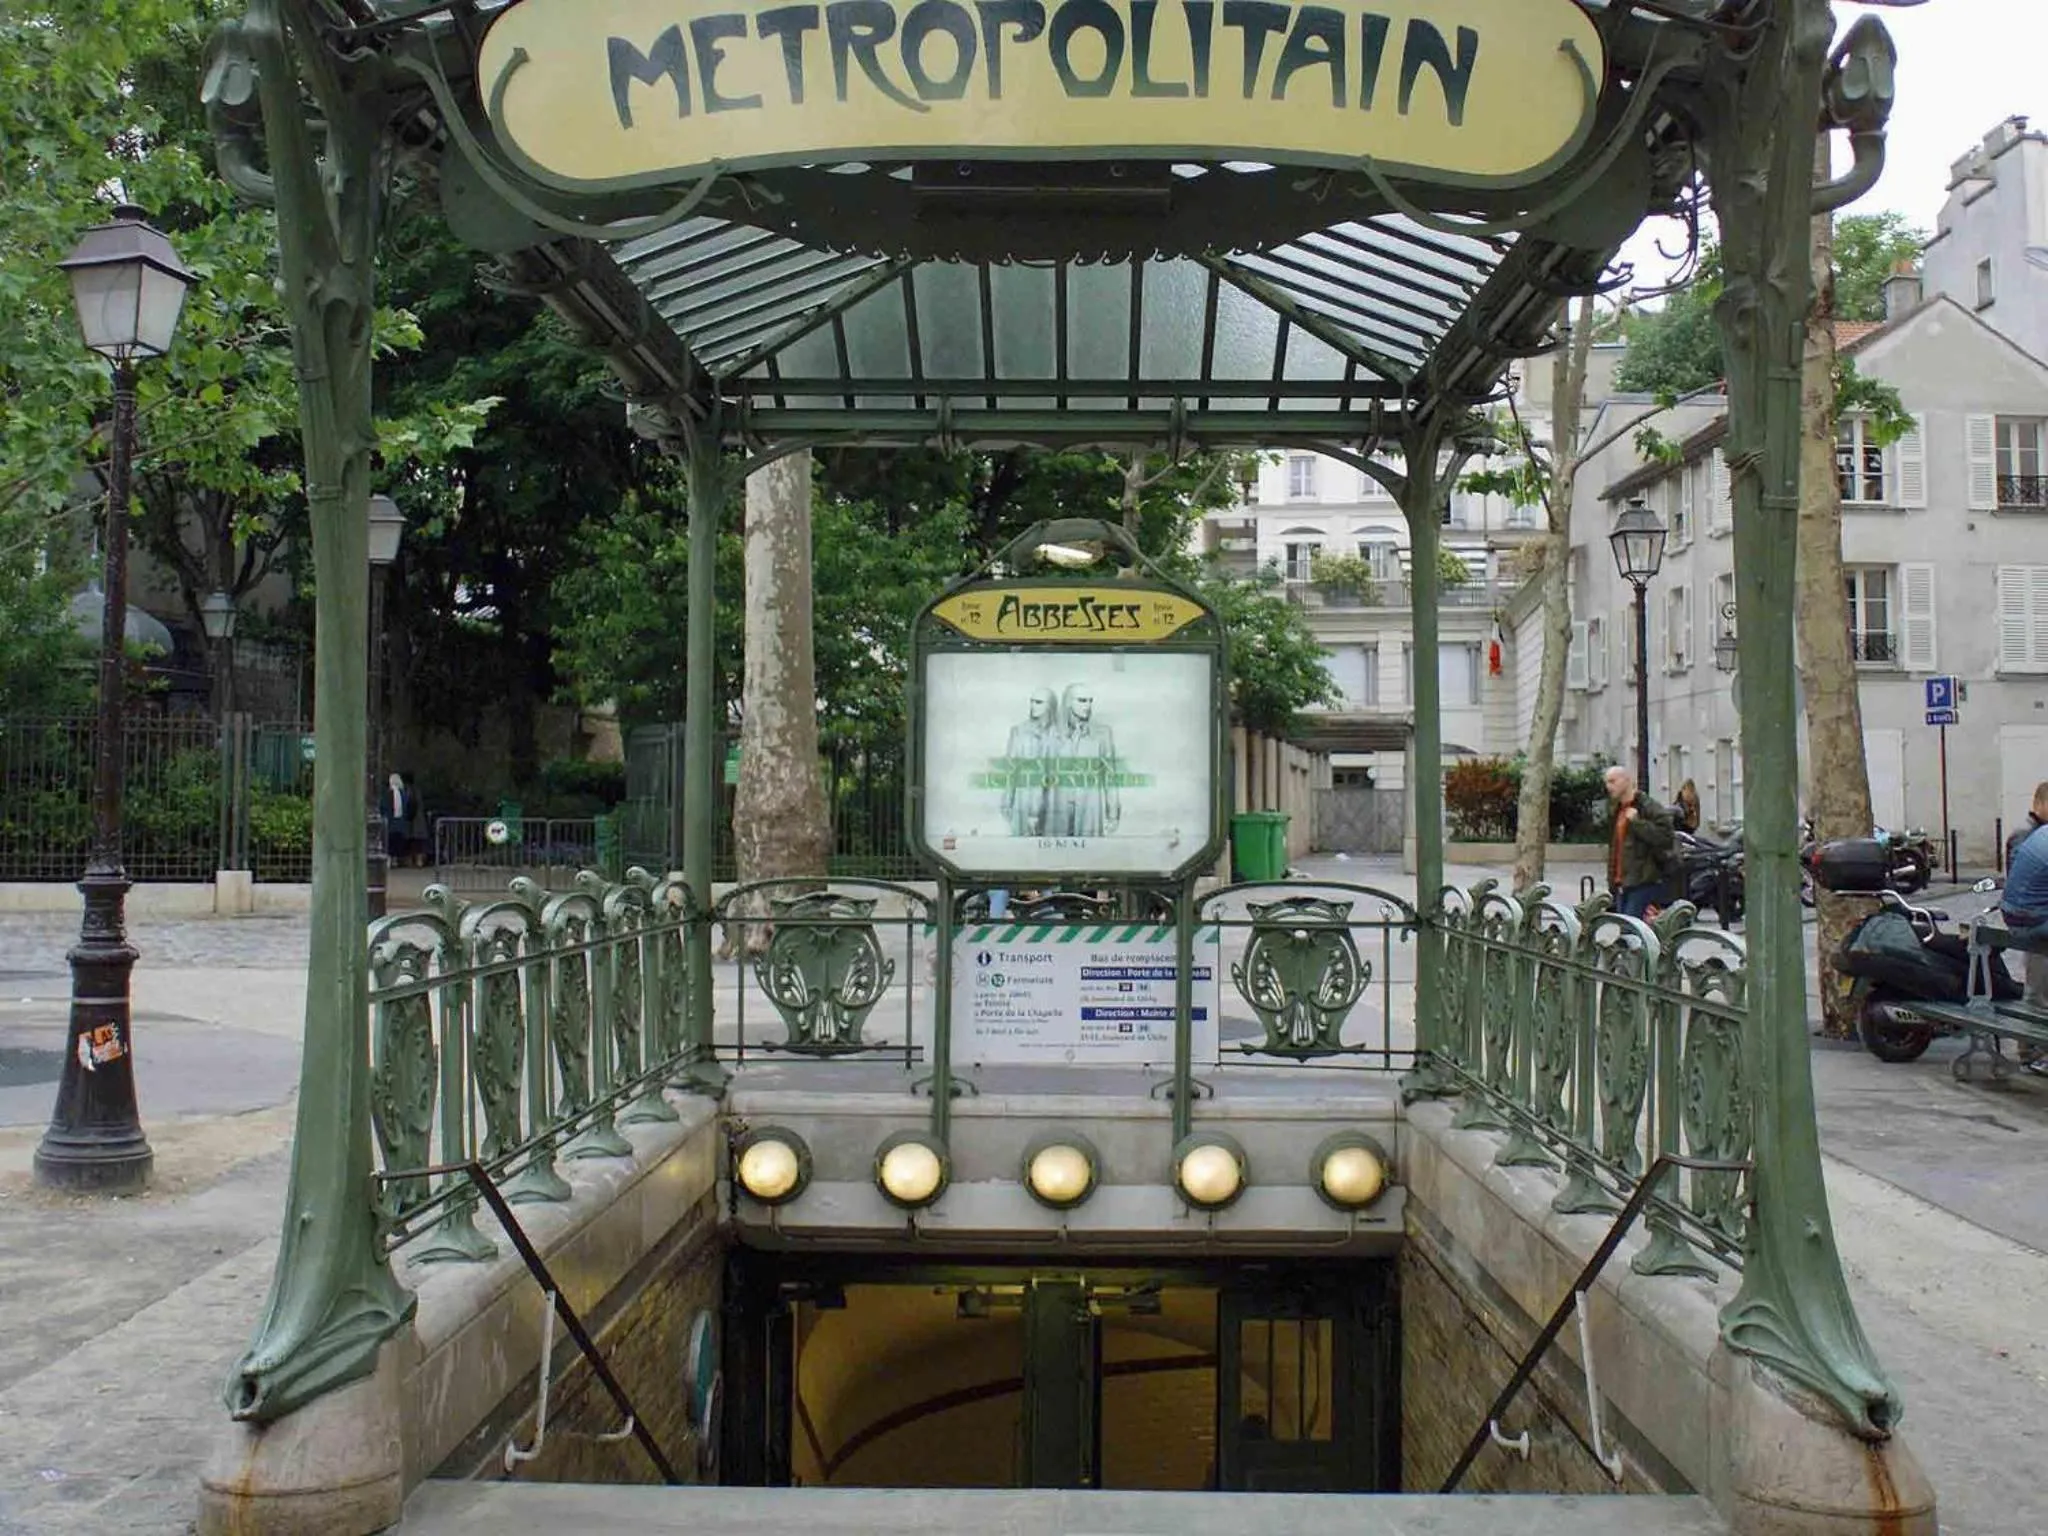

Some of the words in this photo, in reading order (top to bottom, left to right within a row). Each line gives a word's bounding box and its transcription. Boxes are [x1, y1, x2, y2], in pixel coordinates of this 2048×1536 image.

[607, 0, 1479, 131] METROPOLITAIN
[1932, 683, 1944, 703] P
[999, 951, 1053, 965] Transport
[1082, 968, 1121, 977] Direction
[1127, 968, 1150, 977] Porte
[1152, 968, 1163, 977] de
[1095, 1009, 1134, 1017] Direction
